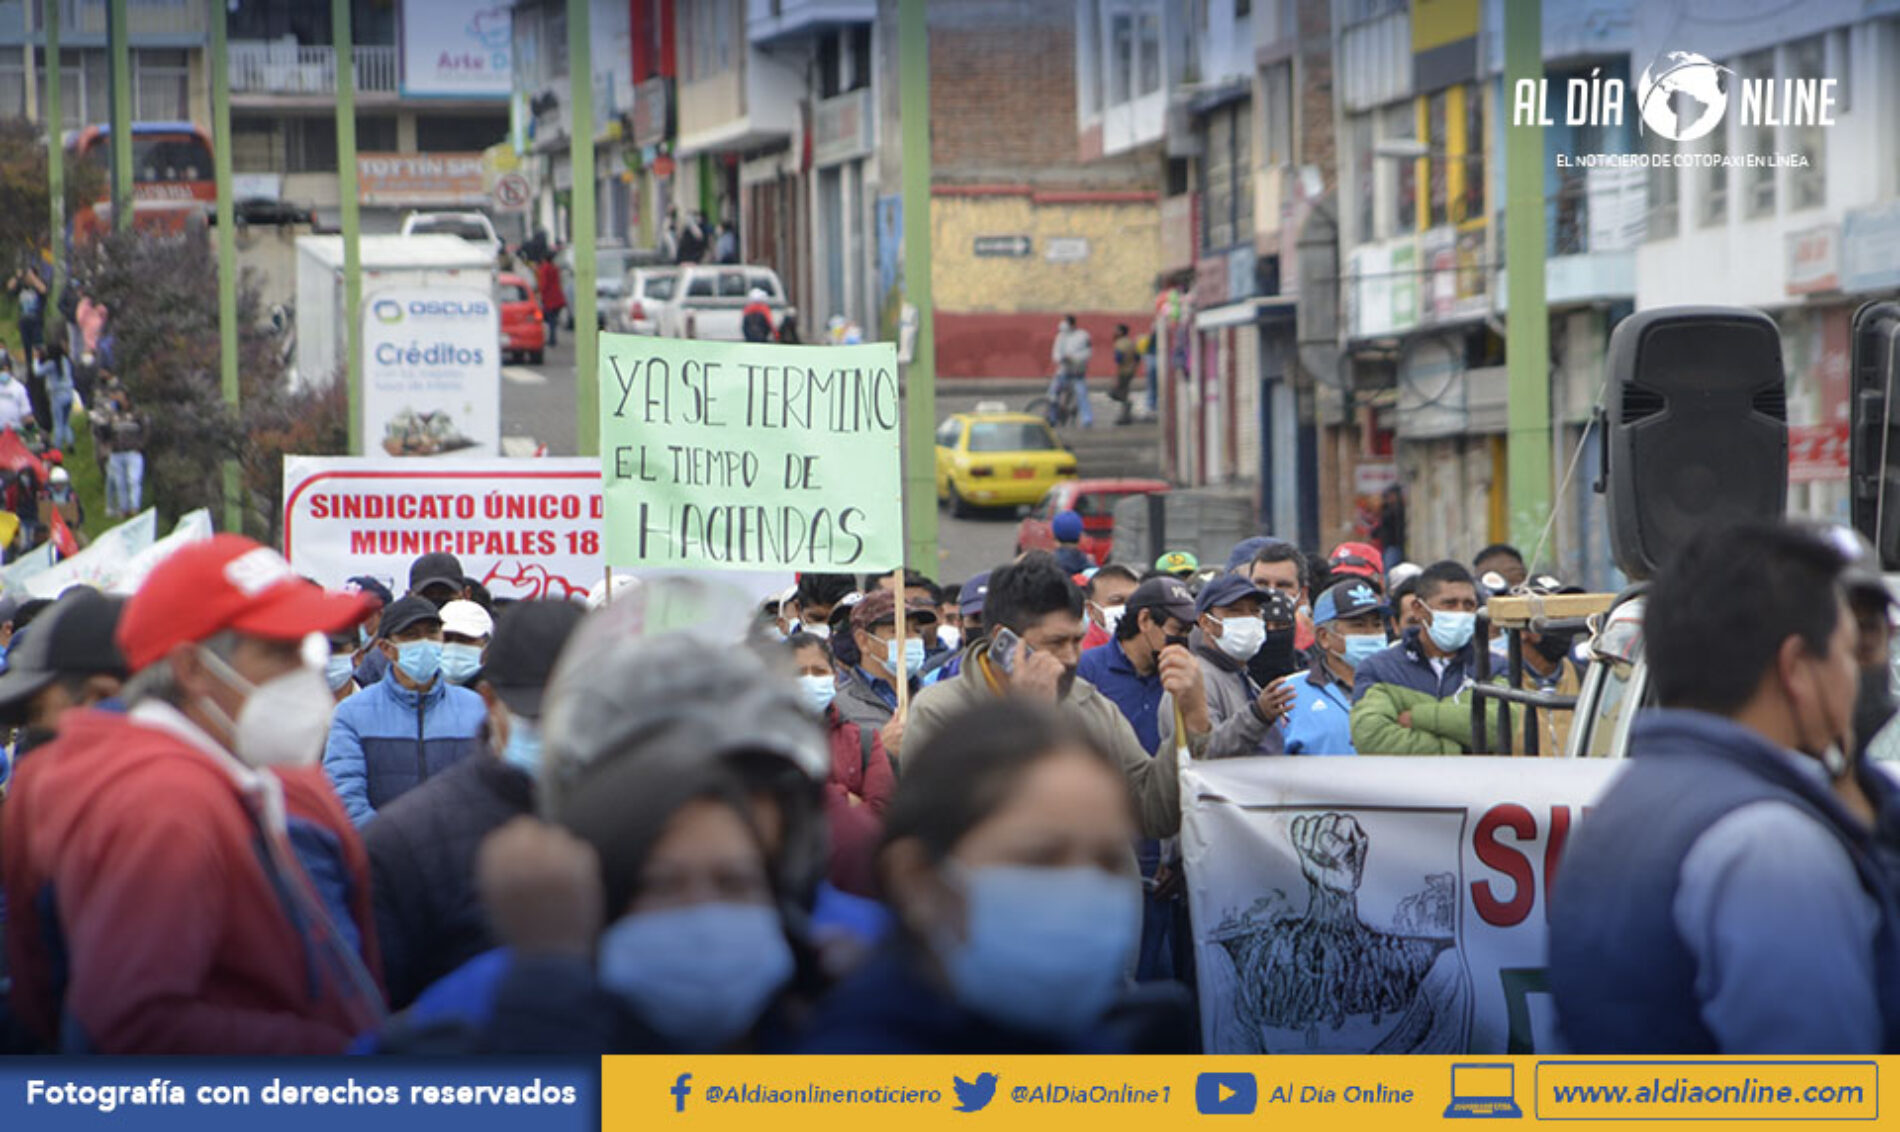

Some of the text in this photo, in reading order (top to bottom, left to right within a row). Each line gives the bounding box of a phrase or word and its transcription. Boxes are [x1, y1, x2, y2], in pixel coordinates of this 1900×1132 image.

[408, 301, 489, 315] OSCUS
[375, 340, 484, 365] Créditos
[738, 363, 898, 433] TERMINO
[615, 445, 822, 489] EL TIEMPO DE
[310, 494, 476, 519] SINDICATO
[484, 490, 580, 519] ÚNICO
[350, 530, 599, 555] MUNICIPALES 18
[638, 503, 866, 566] HACIENDAS
